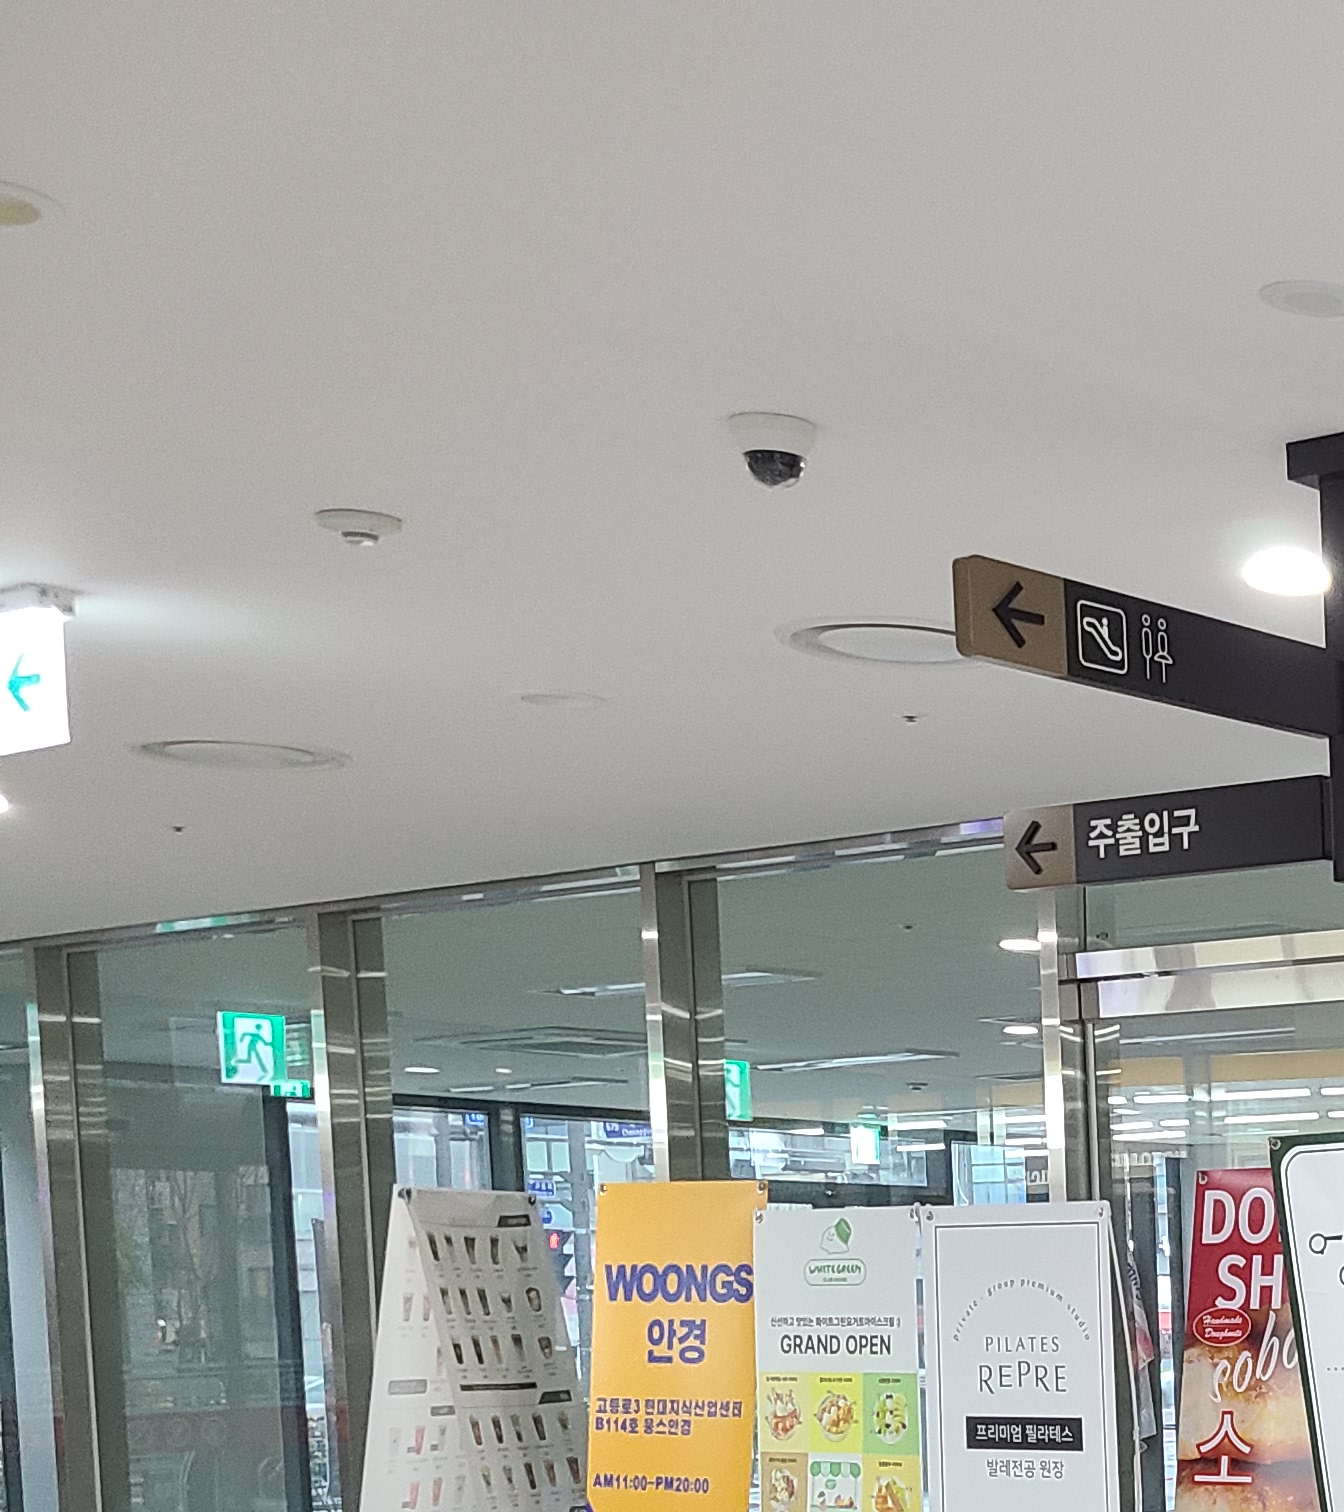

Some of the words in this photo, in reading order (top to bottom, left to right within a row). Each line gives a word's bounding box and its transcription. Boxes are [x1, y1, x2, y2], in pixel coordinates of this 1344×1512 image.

[1087, 808, 1200, 859] 주출입구
[1201, 1187, 1282, 1244] DO
[604, 1263, 754, 1304] WOONGS
[953, 1300, 979, 1342] private
[987, 1279, 1016, 1297] group
[1020, 1278, 1063, 1302] premium
[1066, 1303, 1090, 1341] studio
[647, 1318, 707, 1364] 안경
[780, 1334, 841, 1355] GRAND
[845, 1334, 891, 1355] OPEN
[985, 1336, 1060, 1353] PILATES
[979, 1360, 1067, 1395] REPRE
[644, 1398, 743, 1419] 현대지식산업센터
[595, 1417, 639, 1434] B114호
[643, 1417, 692, 1436] 웅스안경
[975, 1424, 1022, 1443] 프리미엄
[1025, 1424, 1073, 1443] 필라테스
[987, 1459, 1036, 1479] 발레전공
[1039, 1459, 1065, 1480] 원장
[593, 1473, 709, 1494] AM11:00-PM20:00
